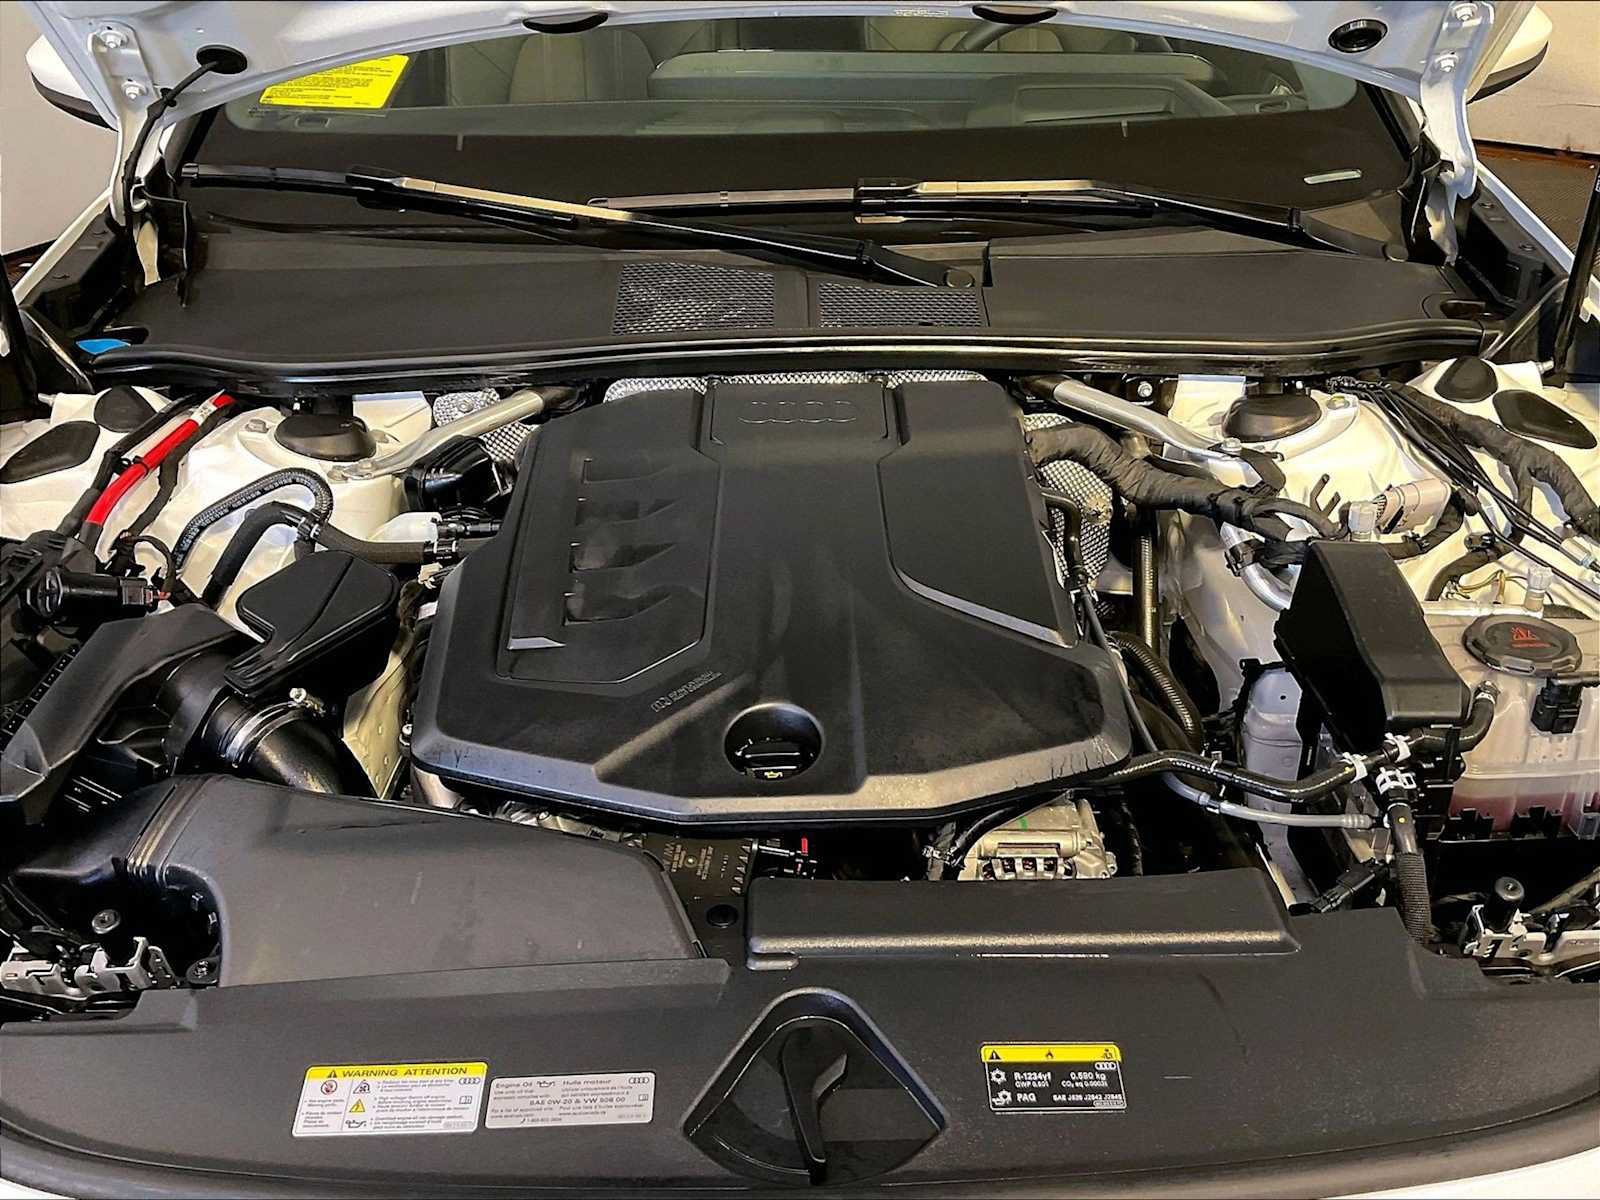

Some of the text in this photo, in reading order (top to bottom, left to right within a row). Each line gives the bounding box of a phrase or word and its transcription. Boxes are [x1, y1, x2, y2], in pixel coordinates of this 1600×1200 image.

[342, 1066, 468, 1078] WARNING ATTENTION
[1017, 1092, 1037, 1102] PAG
